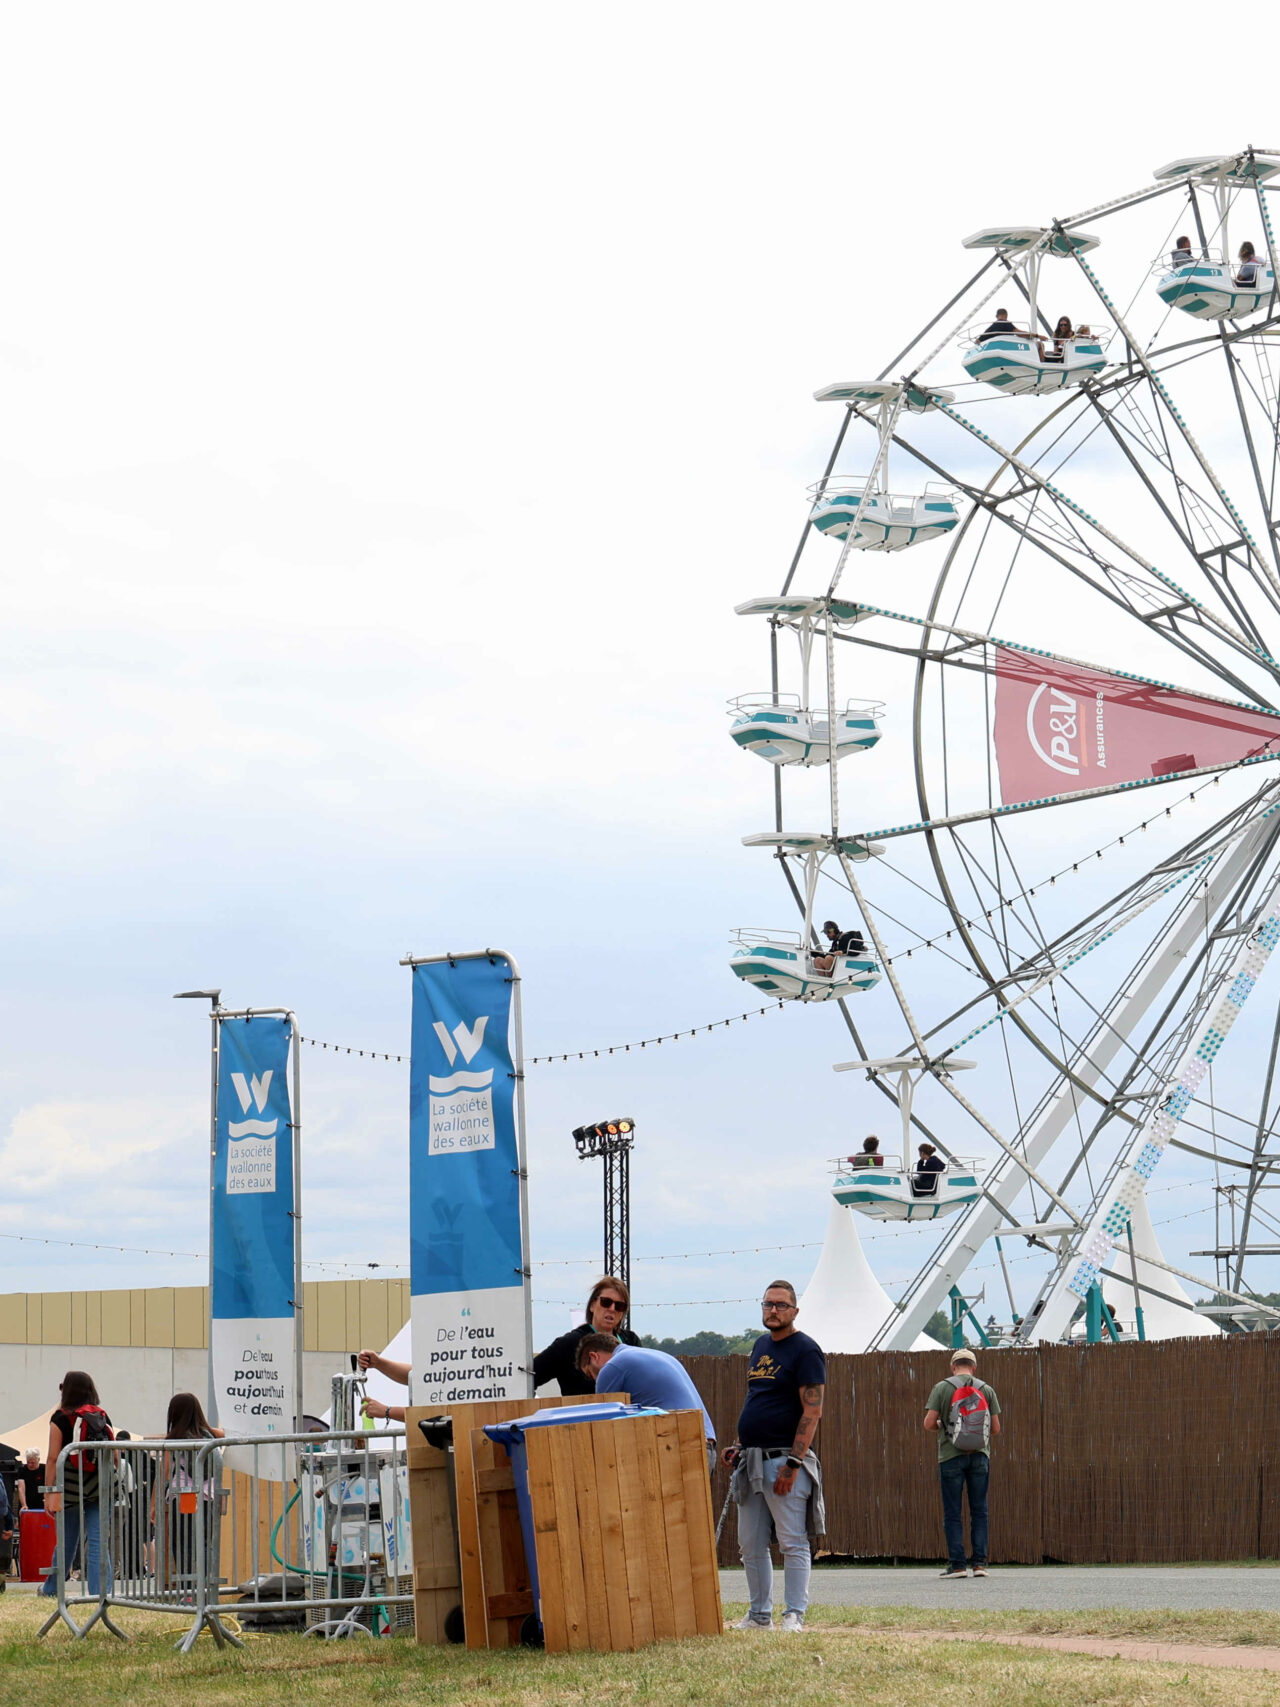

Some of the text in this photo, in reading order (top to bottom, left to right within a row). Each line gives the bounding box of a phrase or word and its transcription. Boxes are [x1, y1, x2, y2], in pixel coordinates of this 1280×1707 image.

[1049, 687, 1079, 764] P&V
[1096, 691, 1106, 768] Assurances
[432, 1097, 488, 1116] La société
[433, 1116, 489, 1132] wallonne
[433, 1133, 490, 1149] des eaux
[231, 1145, 273, 1159] La société
[230, 1161, 272, 1174] wallonne
[229, 1176, 272, 1189] des eaux
[436, 1326, 495, 1342] De l'eau
[242, 1349, 258, 1362] De
[430, 1346, 504, 1365] pour tous
[234, 1370, 264, 1382] pour
[423, 1362, 513, 1384] aujourd'hui
[429, 1383, 506, 1403] et demain
[234, 1403, 248, 1414] et
